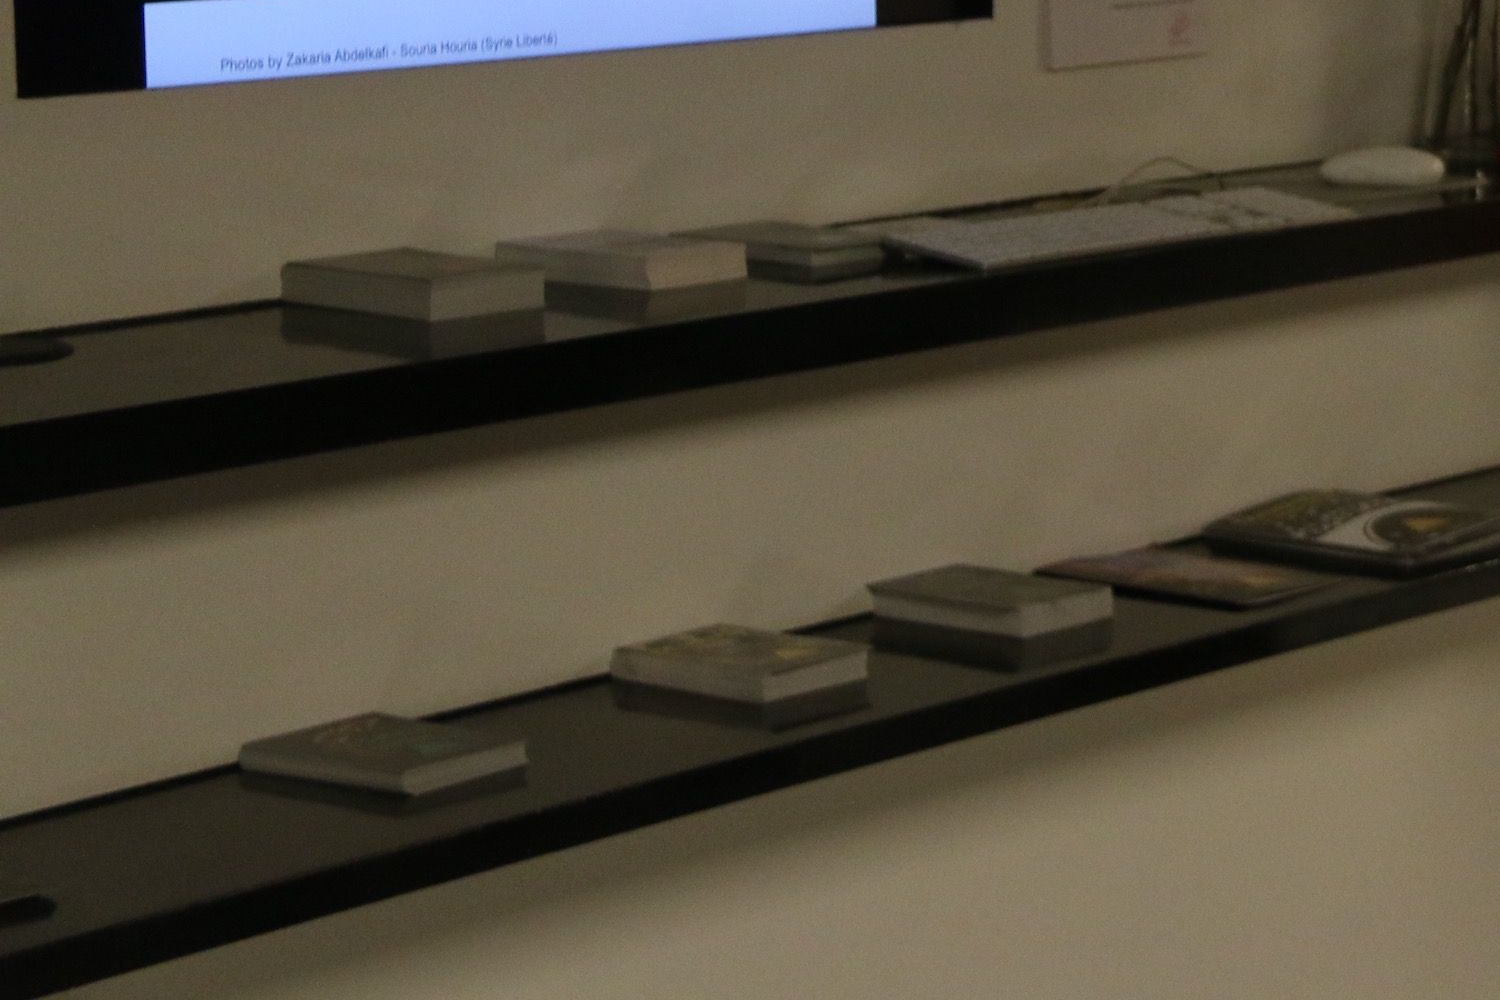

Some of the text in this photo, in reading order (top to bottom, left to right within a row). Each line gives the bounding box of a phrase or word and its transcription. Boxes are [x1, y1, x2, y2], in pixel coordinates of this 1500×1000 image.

[219, 56, 264, 72] Photos
[267, 55, 283, 70] by
[286, 52, 331, 67] Zakaria
[334, 46, 389, 62] Abdelkafi
